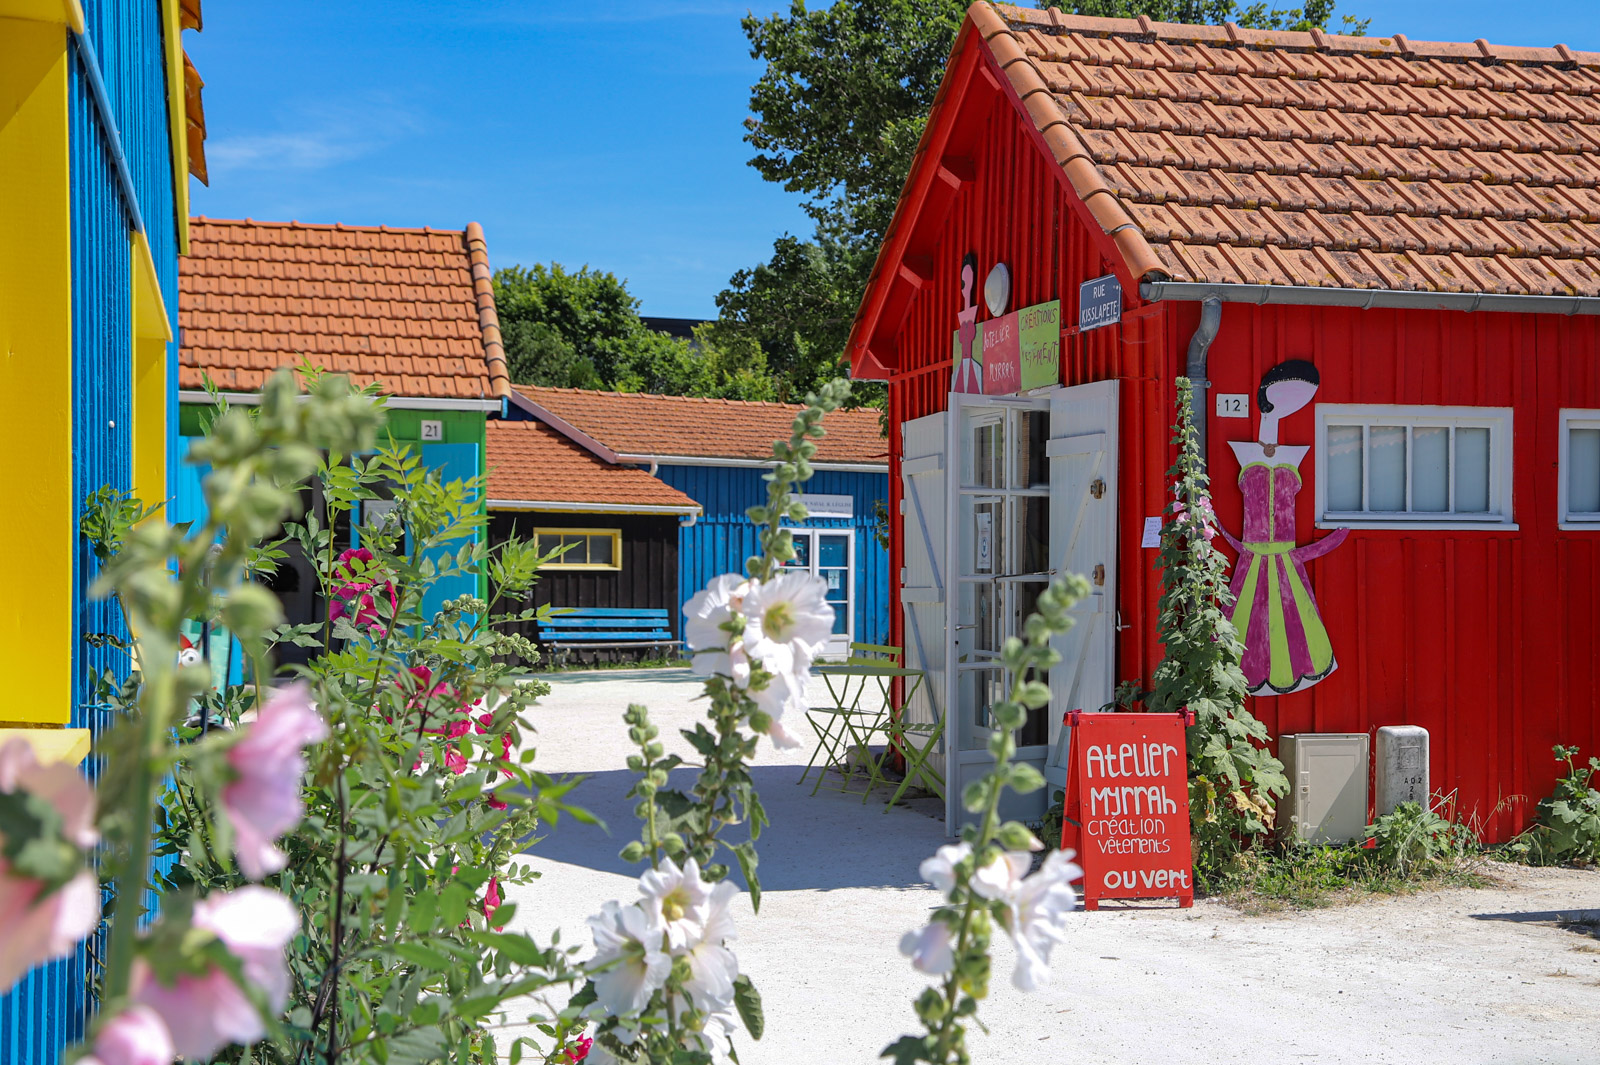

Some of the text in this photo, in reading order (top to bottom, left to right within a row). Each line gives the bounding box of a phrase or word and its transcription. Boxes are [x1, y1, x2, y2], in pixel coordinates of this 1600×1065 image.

[1093, 284, 1106, 299] RUE
[1081, 300, 1118, 324] KISSLAPETE
[1225, 399, 1241, 411] 12
[424, 424, 438, 437] 21
[1086, 734, 1178, 778] Atelier
[1087, 815, 1165, 836] création
[1097, 836, 1171, 854] vêtements
[1103, 869, 1192, 889] ouvert
